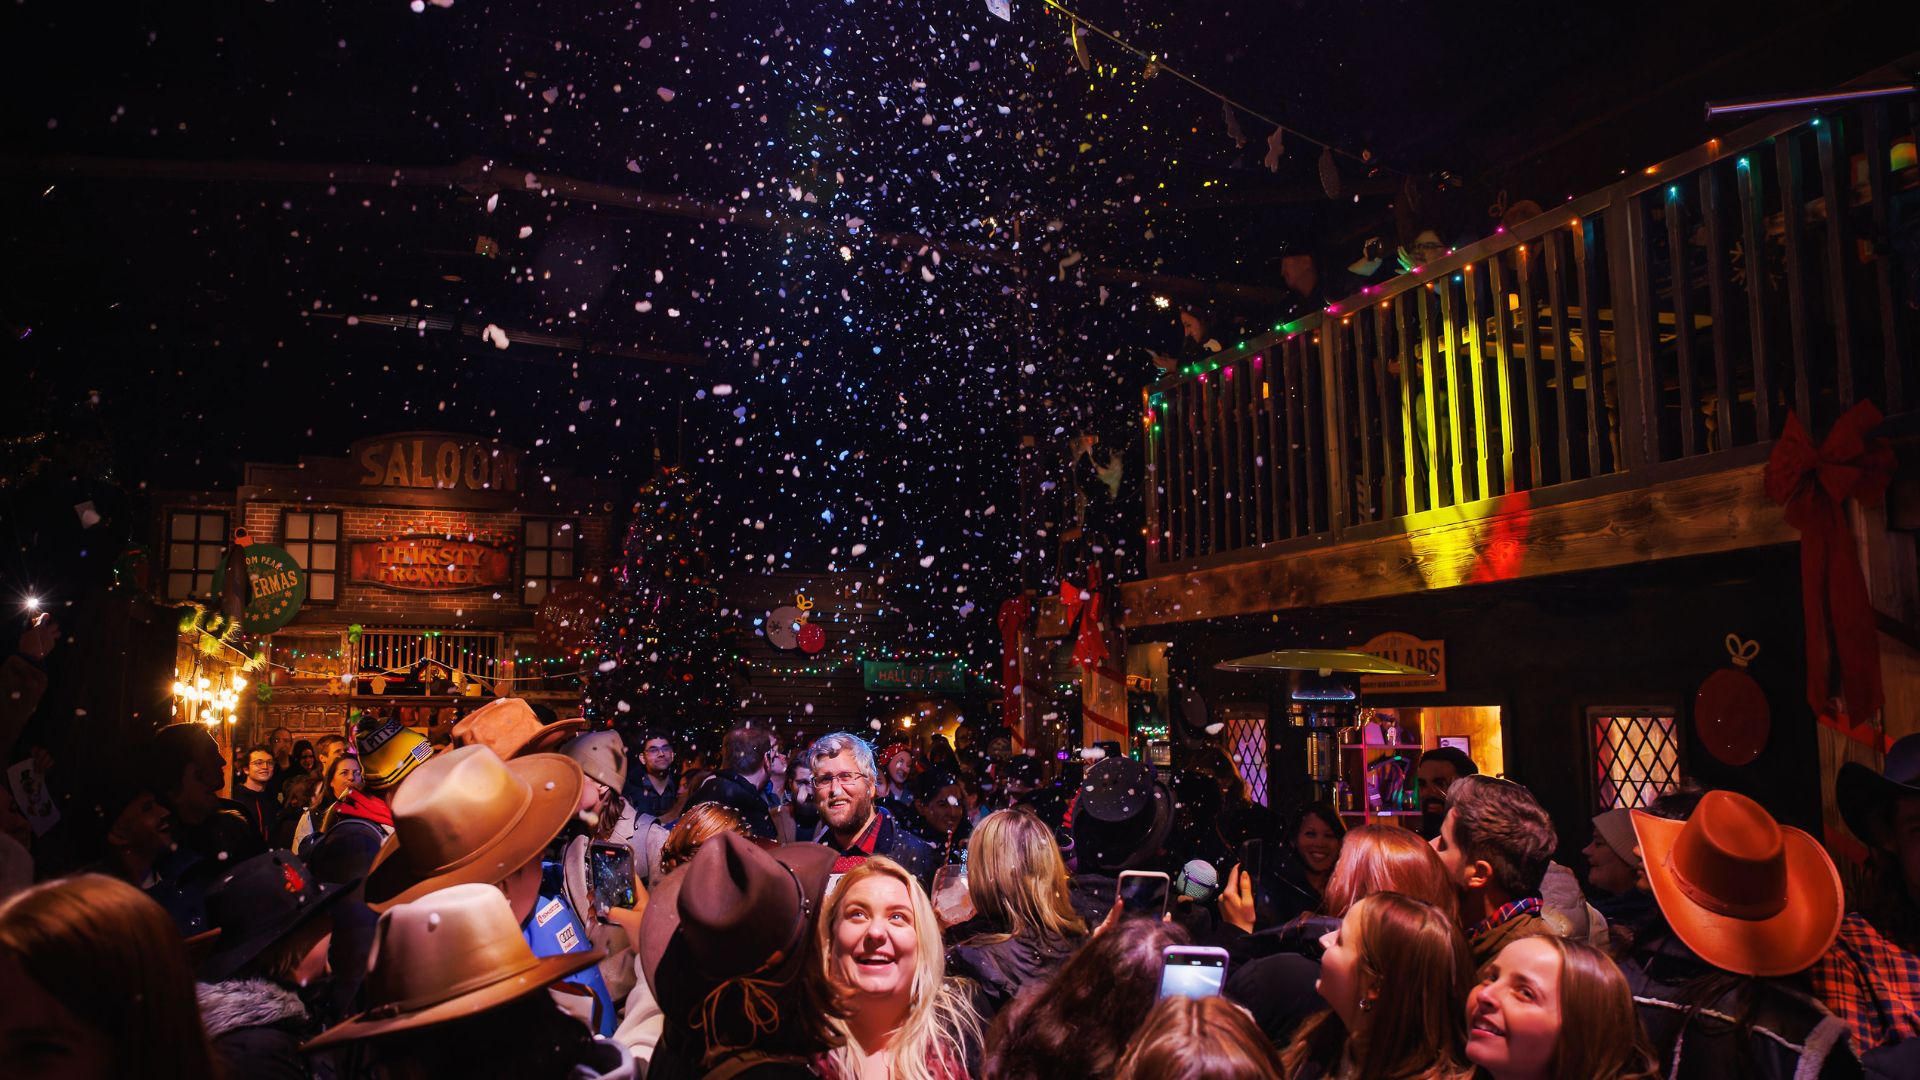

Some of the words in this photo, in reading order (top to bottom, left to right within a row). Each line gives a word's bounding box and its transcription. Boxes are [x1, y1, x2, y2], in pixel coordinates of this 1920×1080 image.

[360, 440, 518, 490] SALOON
[422, 538, 442, 547] THE
[378, 546, 486, 565] THIRSTY
[378, 567, 484, 583] FRONTIER
[252, 570, 298, 599] ERMAS
[878, 669, 907, 683] HALL
